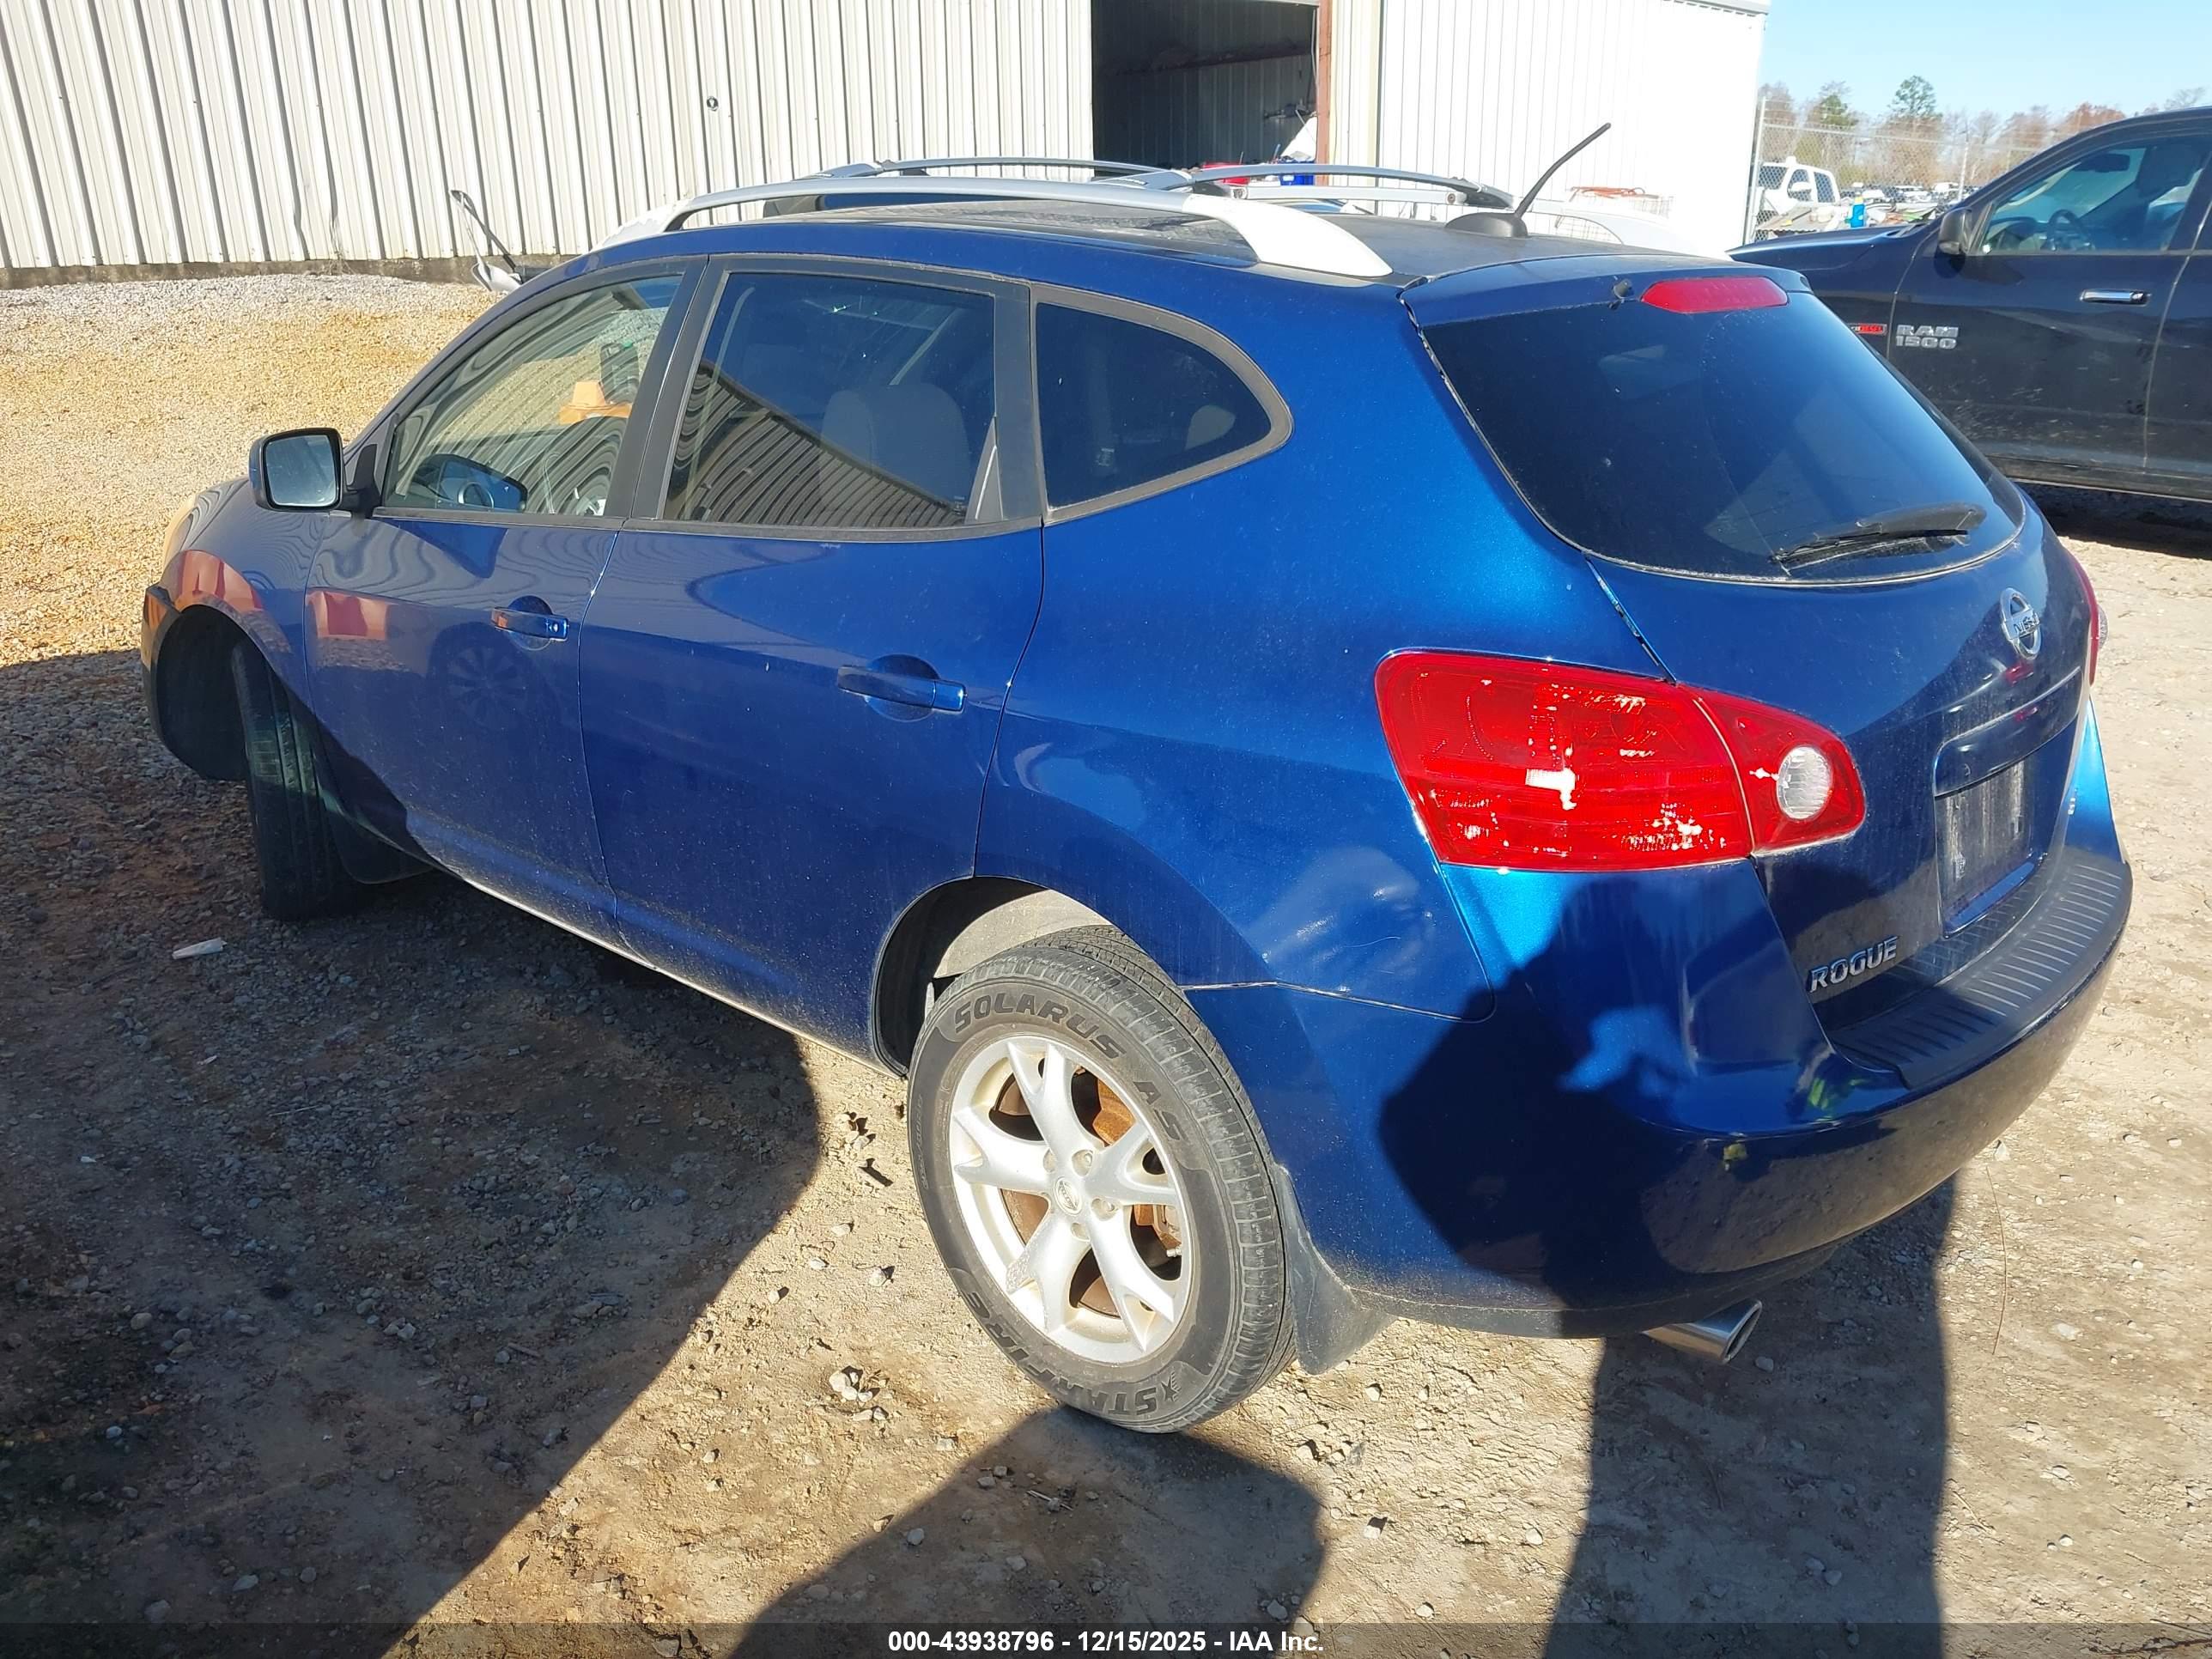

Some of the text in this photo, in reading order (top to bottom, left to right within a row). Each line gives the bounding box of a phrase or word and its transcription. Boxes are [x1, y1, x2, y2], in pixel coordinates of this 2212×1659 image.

[1895, 336, 1957, 349] 1500
[1897, 325, 1959, 337] RAM
[1808, 935, 1899, 993] ROGUE
[955, 993, 1127, 1059] SOLARUS
[967, 1291, 1158, 1416] STARFIRE
